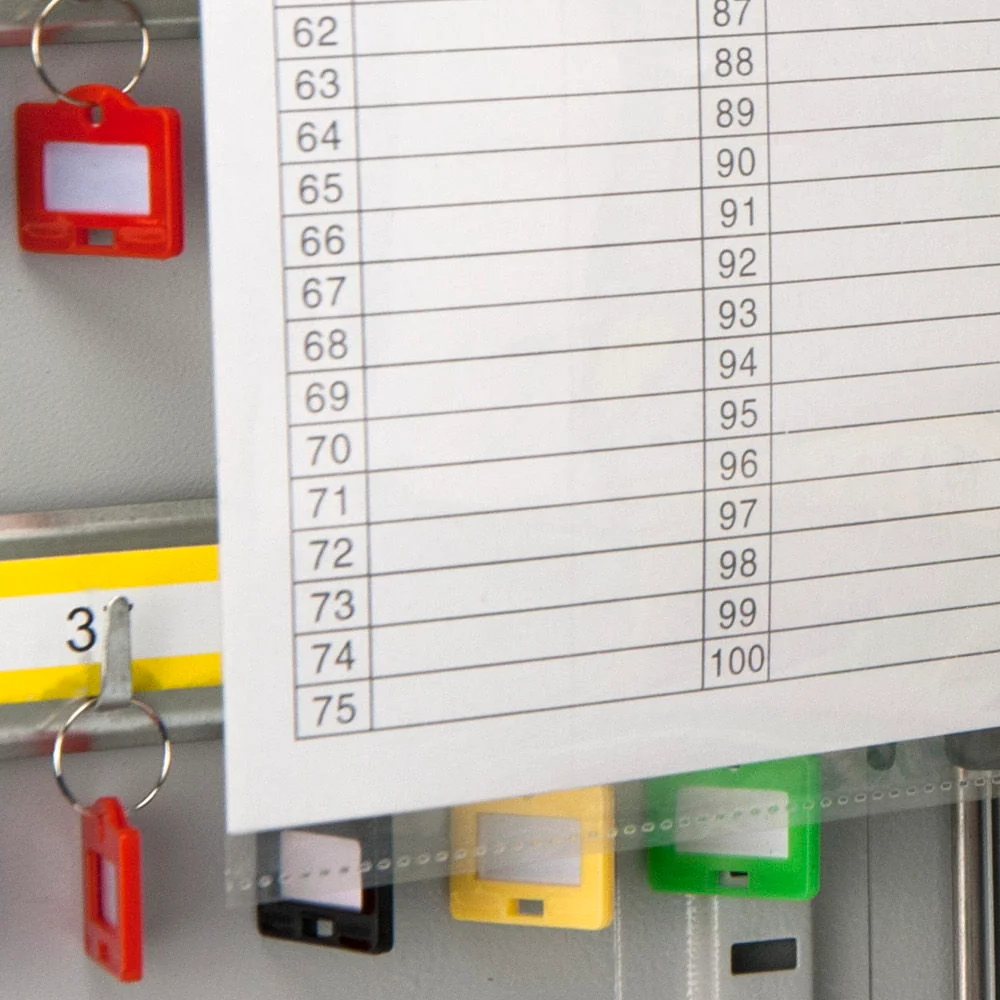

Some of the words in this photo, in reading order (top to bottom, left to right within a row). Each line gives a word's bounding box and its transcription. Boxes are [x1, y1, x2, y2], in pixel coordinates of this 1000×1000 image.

[294, 16, 337, 47] 62
[715, 47, 753, 77] 88
[296, 69, 339, 100] 63
[717, 98, 754, 128] 89
[298, 121, 341, 152] 64
[717, 147, 755, 177] 90
[299, 173, 342, 204] 65
[721, 197, 753, 228] 91
[301, 225, 344, 256] 66
[719, 248, 756, 278] 92
[303, 276, 346, 308] 67
[719, 298, 757, 329] 93
[304, 329, 347, 361] 68
[720, 347, 757, 379] 94
[306, 381, 348, 413] 69
[721, 399, 757, 430] 95
[308, 434, 350, 465] 70
[720, 449, 757, 480] 96
[309, 487, 345, 517] 71
[720, 499, 757, 530] 97
[310, 538, 353, 569] 72
[720, 548, 757, 579] 98
[311, 590, 355, 622] 73
[720, 598, 756, 629] 99
[66, 604, 134, 653] 3
[312, 641, 354, 673] 74
[712, 644, 764, 676] 100
[314, 693, 356, 725] 75
